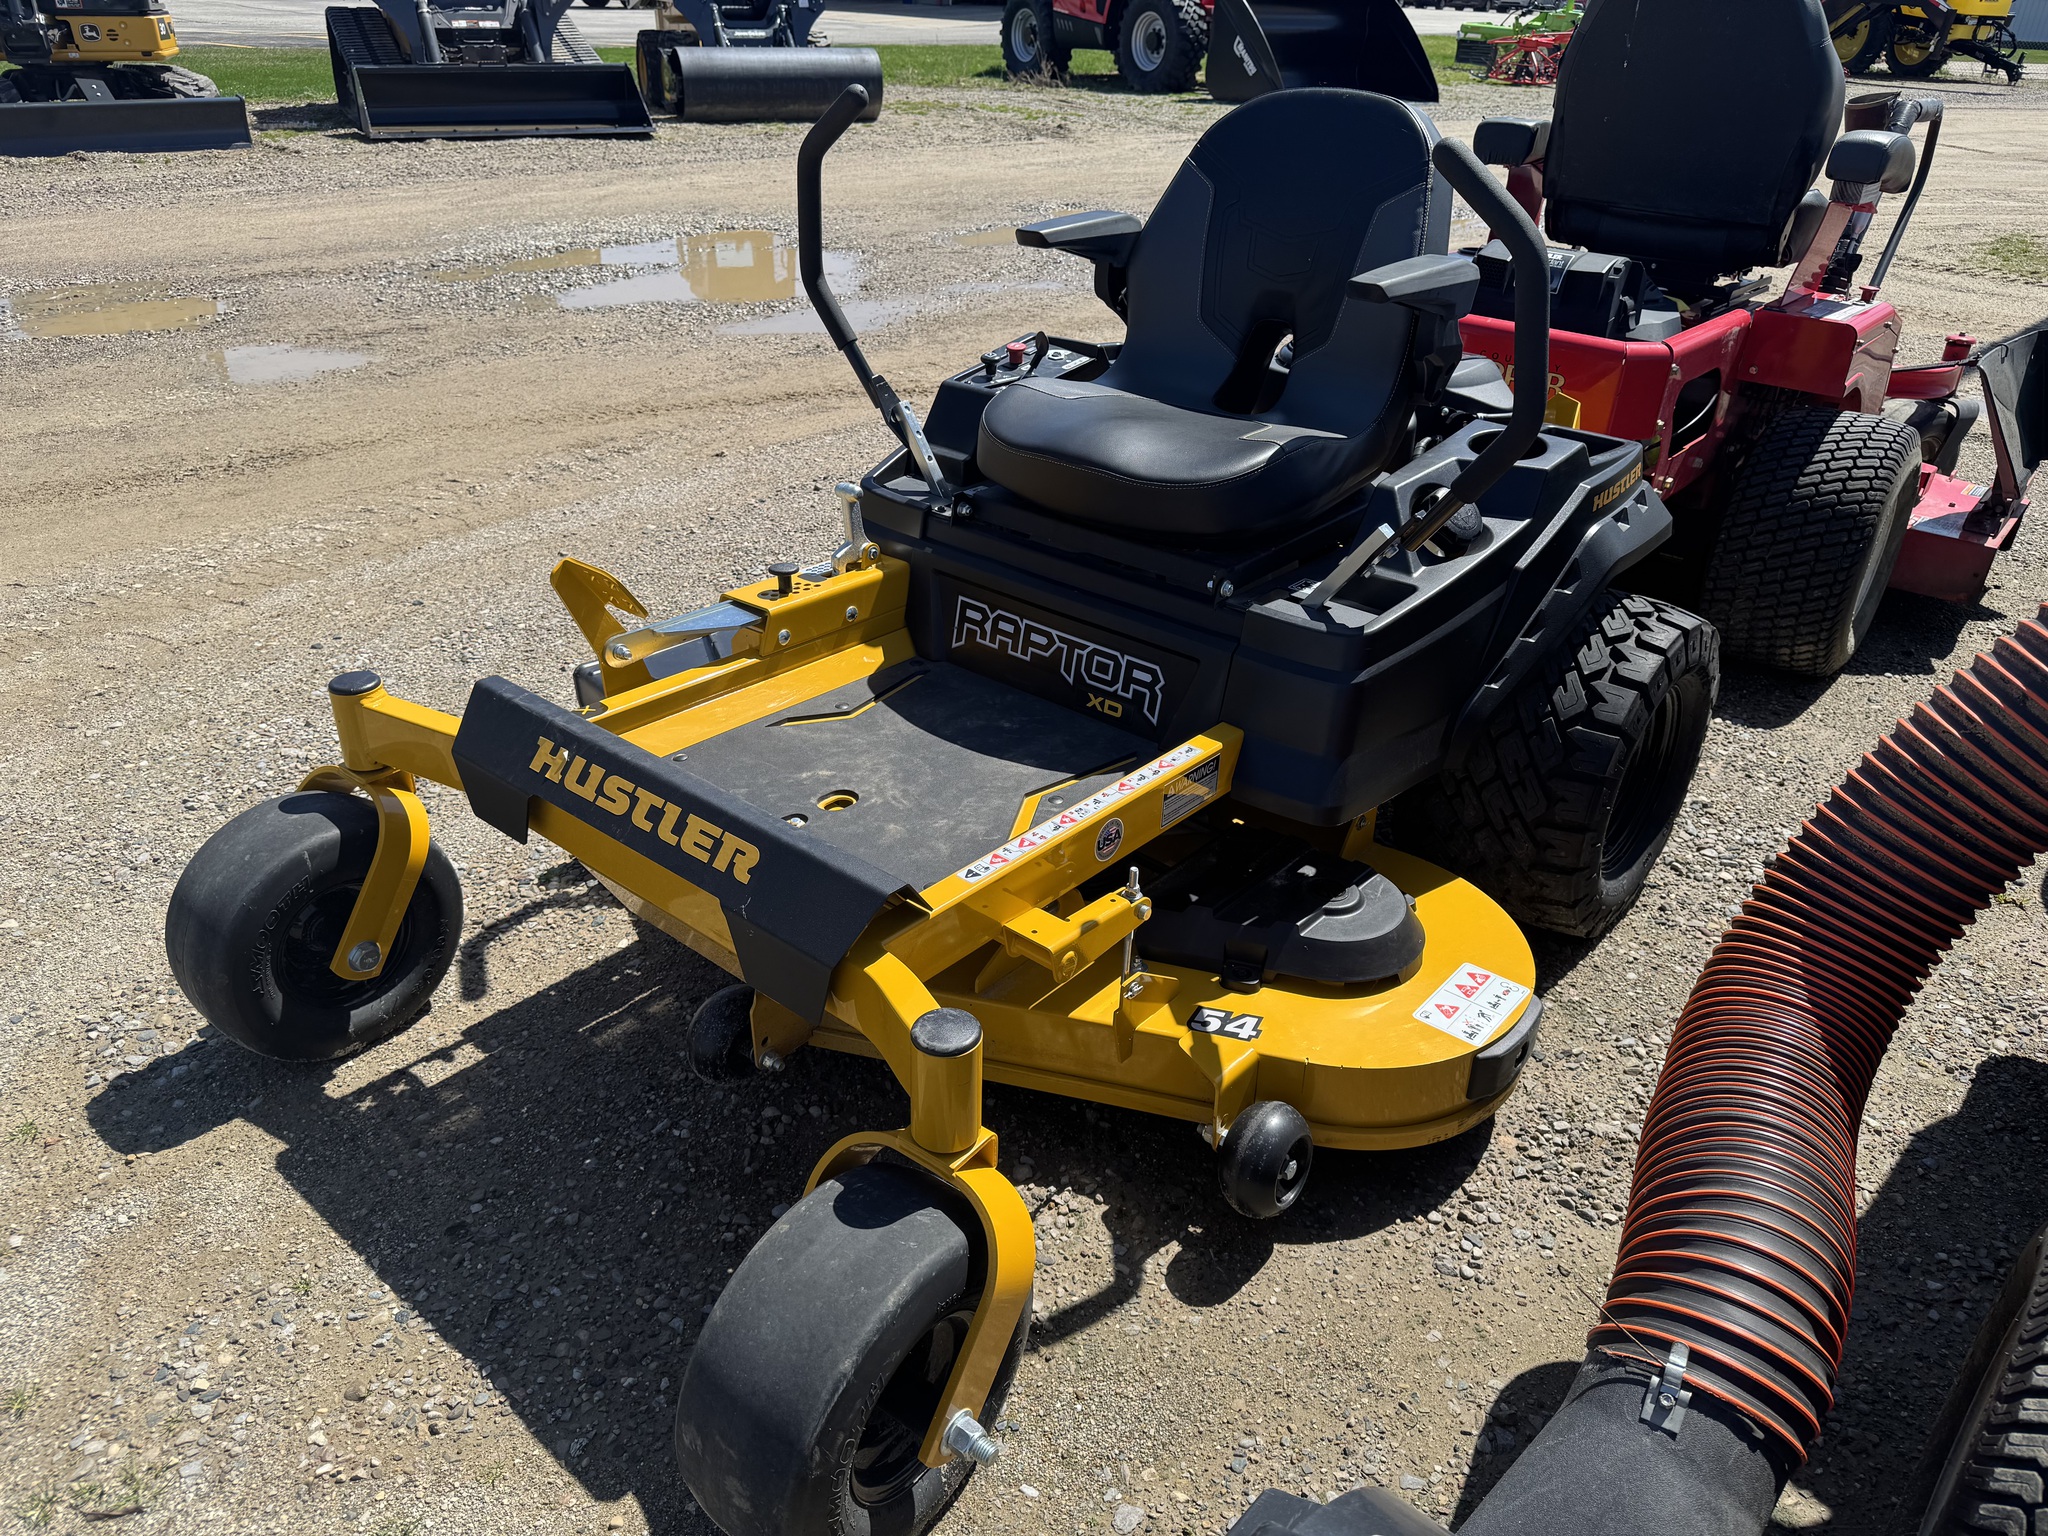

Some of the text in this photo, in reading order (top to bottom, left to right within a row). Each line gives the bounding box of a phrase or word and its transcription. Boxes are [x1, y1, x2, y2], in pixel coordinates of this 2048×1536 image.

[1592, 462, 1642, 513] HUSTLER
[951, 595, 1166, 727] RAPTOR
[1086, 692, 1123, 718] XD
[529, 736, 761, 885] HUSTLER
[1097, 829, 1121, 851] USA
[1190, 1008, 1260, 1040] 54
